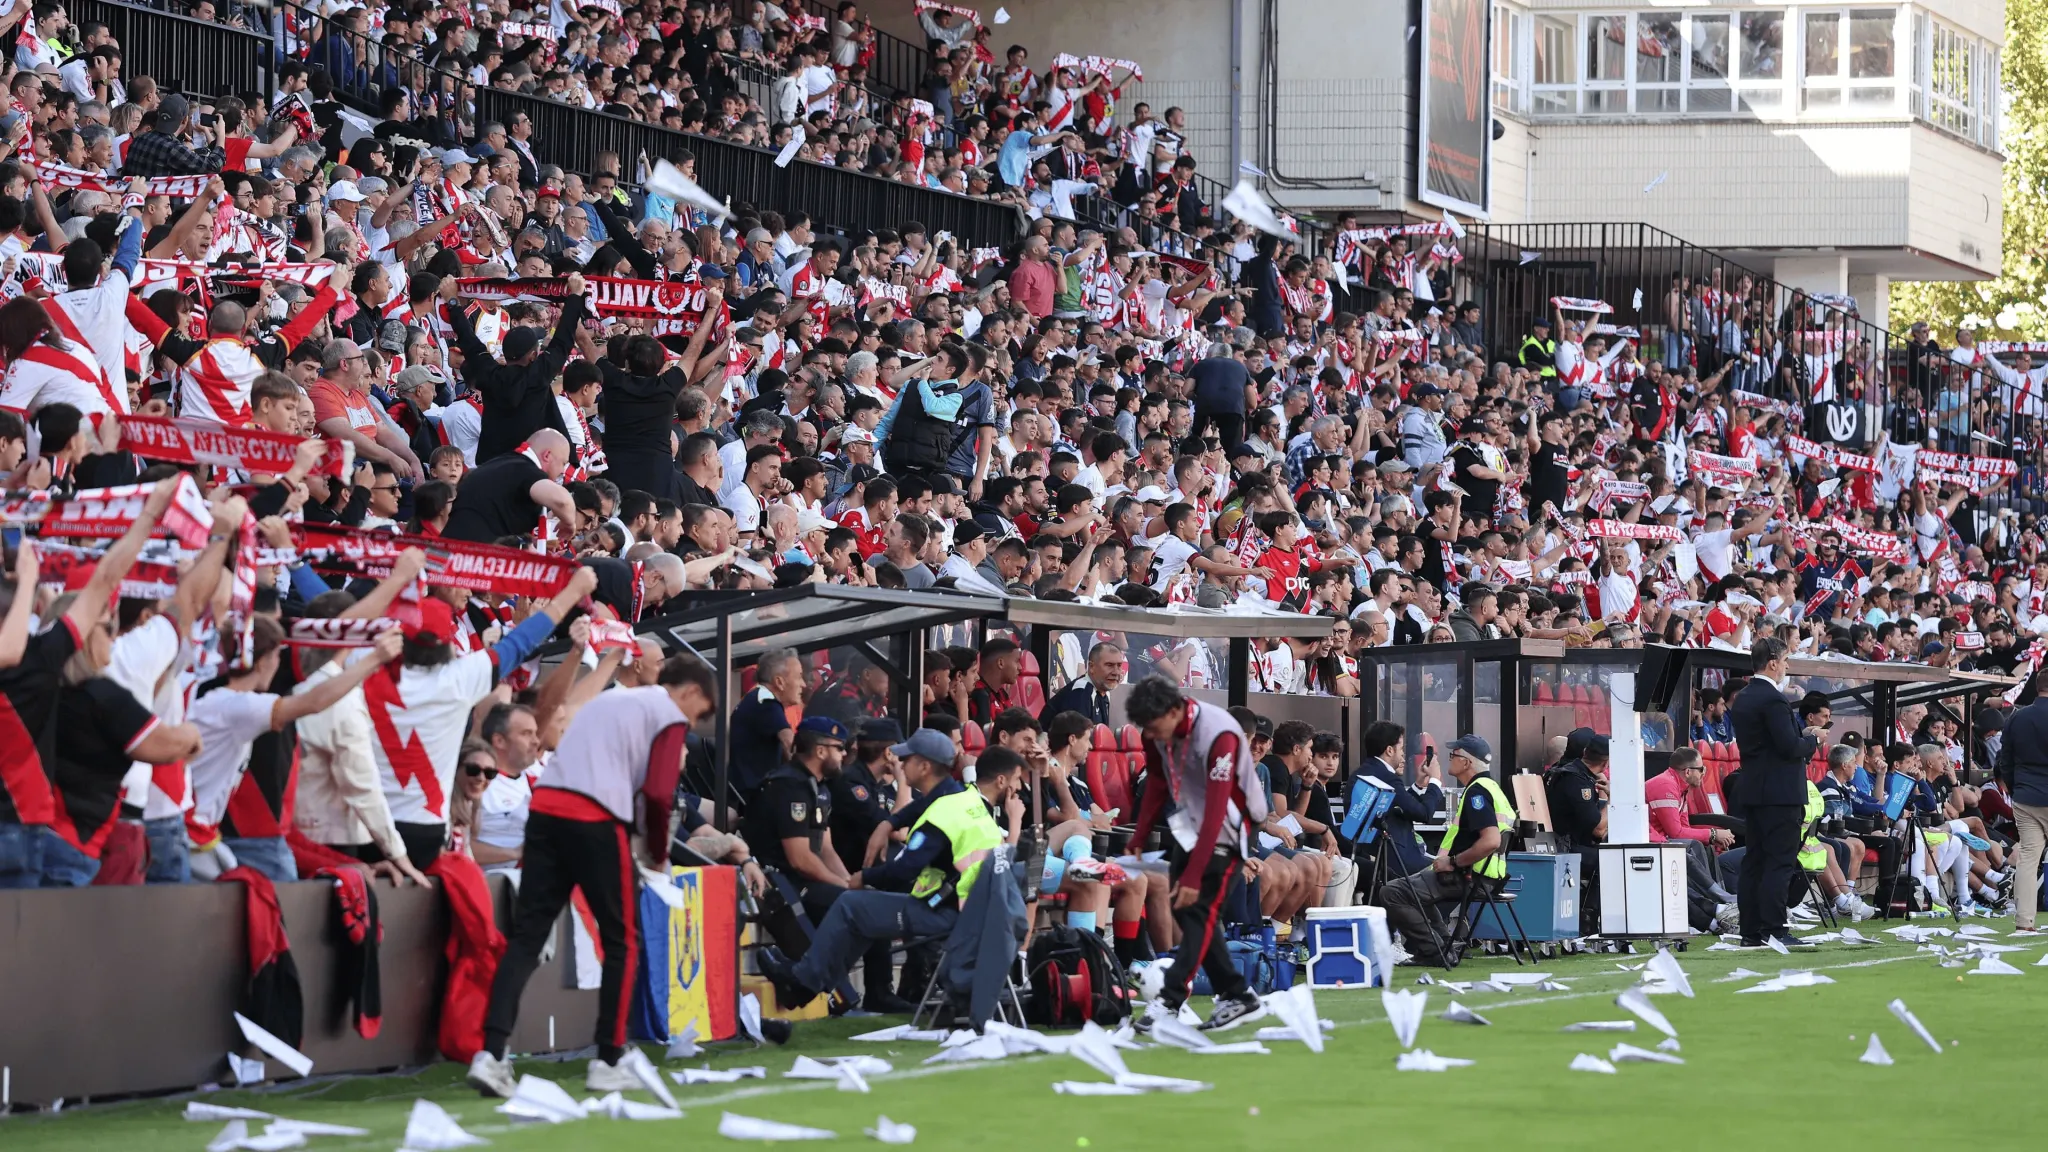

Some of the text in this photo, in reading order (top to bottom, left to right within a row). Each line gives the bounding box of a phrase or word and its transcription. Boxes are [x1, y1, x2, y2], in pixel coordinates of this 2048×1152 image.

[1789, 435, 1821, 458] RESA
[1840, 451, 1870, 469] VETE
[1919, 450, 1957, 469] PRESA
[1974, 457, 2003, 473] VETE
[1285, 576, 1310, 591] DIG
